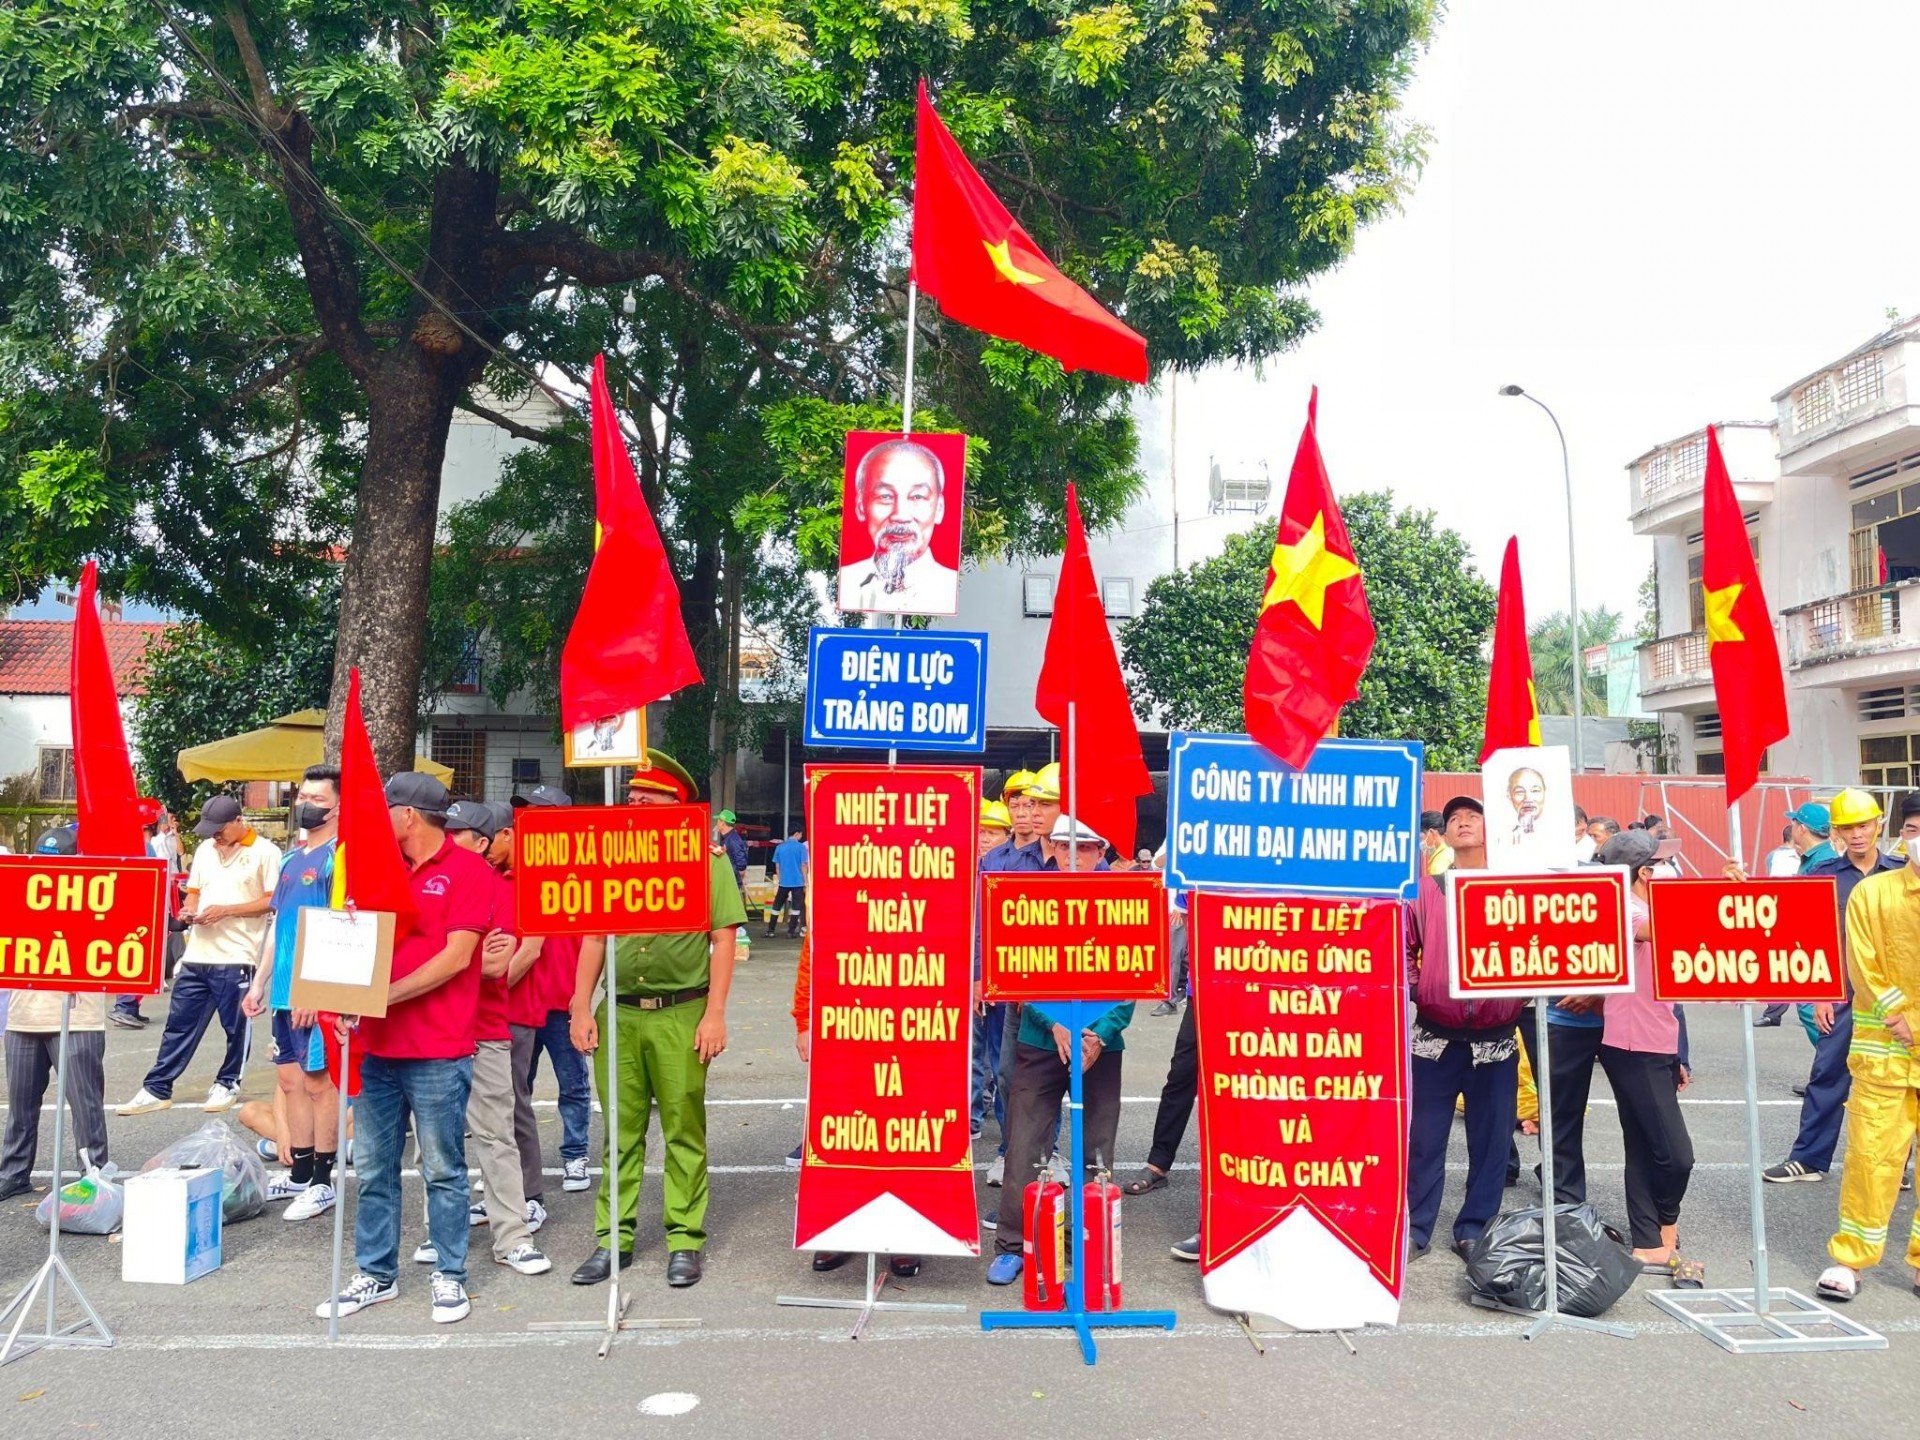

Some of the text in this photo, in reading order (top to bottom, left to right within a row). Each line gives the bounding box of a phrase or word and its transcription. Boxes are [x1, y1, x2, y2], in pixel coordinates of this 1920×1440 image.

[841, 645, 954, 690] ĐIỆN LỰC
[823, 690, 969, 734] TRẢNG BOM
[1190, 762, 1399, 808] CÔNG TY TNHH MTV
[835, 785, 949, 833] NHIỆT LIỆT
[523, 817, 700, 868] UBND XÃ QUẢNG TIẾN
[829, 834, 955, 879] HƯỞNG ỨNG
[1178, 820, 1410, 865] CƠ KHI ĐẠI ANH PHÁT
[26, 872, 117, 920] CHỢ
[540, 873, 685, 922] ĐỘI PCCC
[1002, 893, 1149, 926] CÔNG TY TNHH
[1484, 888, 1598, 931] ĐỘI PCCC
[1718, 894, 1778, 938] CHỢ
[1223, 902, 1367, 936] NHIỆT LIỆT
[85, 926, 148, 978] CỔ
[836, 946, 945, 987] TOÀN DÂN
[996, 937, 1155, 979] THỊNH TIẾN ĐẠT
[1214, 940, 1372, 973] HƯỞNG ỨNG
[1470, 934, 1616, 978] XÃ BẮC SƠN
[1671, 941, 1833, 984] ĐÔNG HÒA
[821, 998, 960, 1042] PHÒNG CHÁY
[1226, 1027, 1362, 1057] TOÀN DÂN
[874, 1056, 903, 1097] VÀ
[1214, 1069, 1383, 1101] PHÒNG CHÁY
[820, 1109, 879, 1152] CHỮA
[1279, 1113, 1313, 1144] VÀ
[1219, 1152, 1287, 1187] CHỮA
